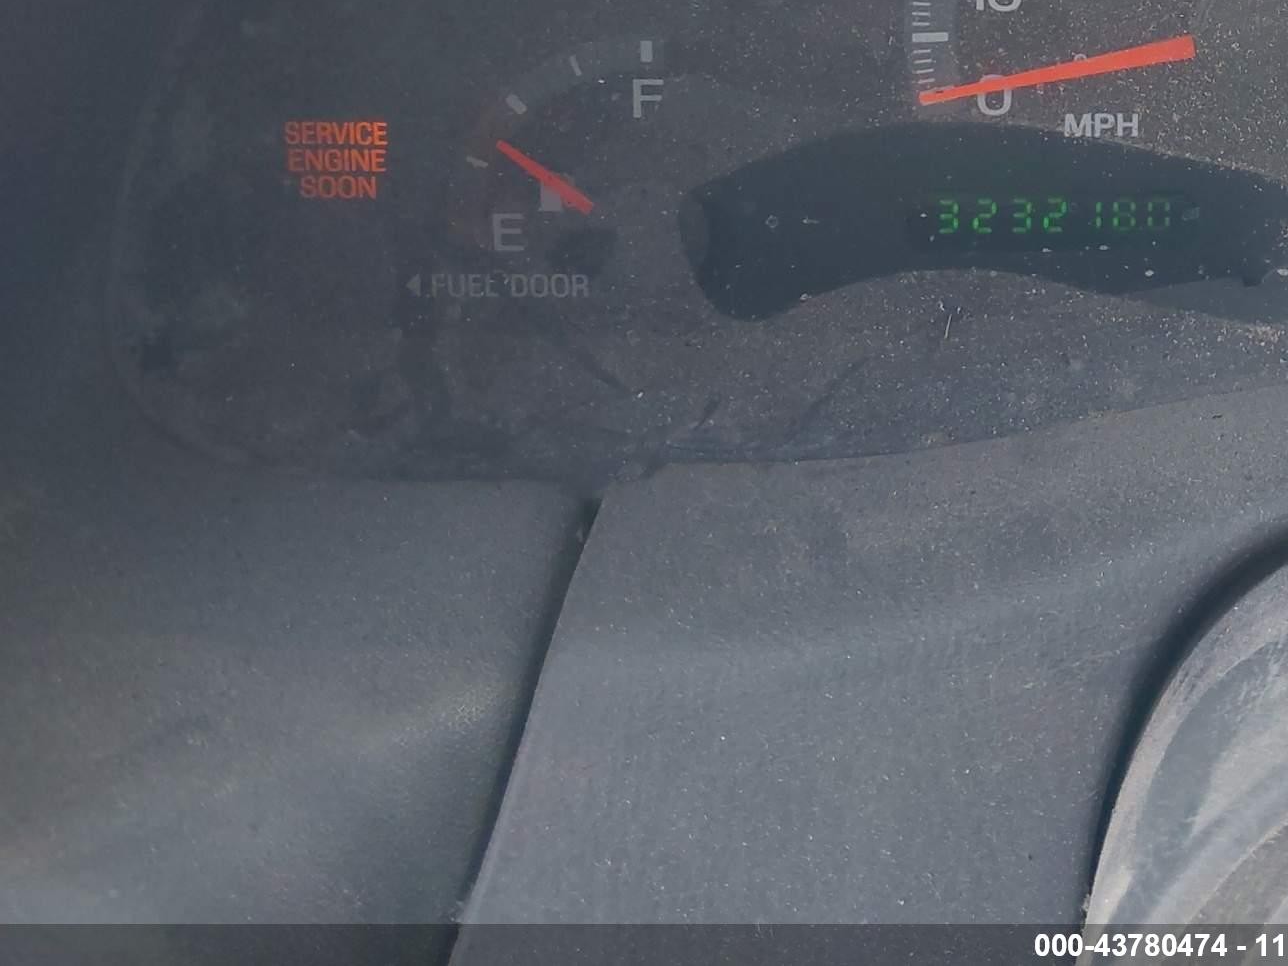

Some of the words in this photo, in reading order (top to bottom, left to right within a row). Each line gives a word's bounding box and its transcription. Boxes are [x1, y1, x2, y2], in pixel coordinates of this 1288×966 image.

[633, 79, 664, 118] F
[285, 121, 388, 146] SERVICE
[1064, 113, 1139, 137] MPH
[287, 149, 387, 172] ENGINE
[300, 175, 377, 200] SOON
[493, 213, 526, 251] E
[431, 274, 498, 297] FUEL
[511, 274, 589, 297] DOOR
